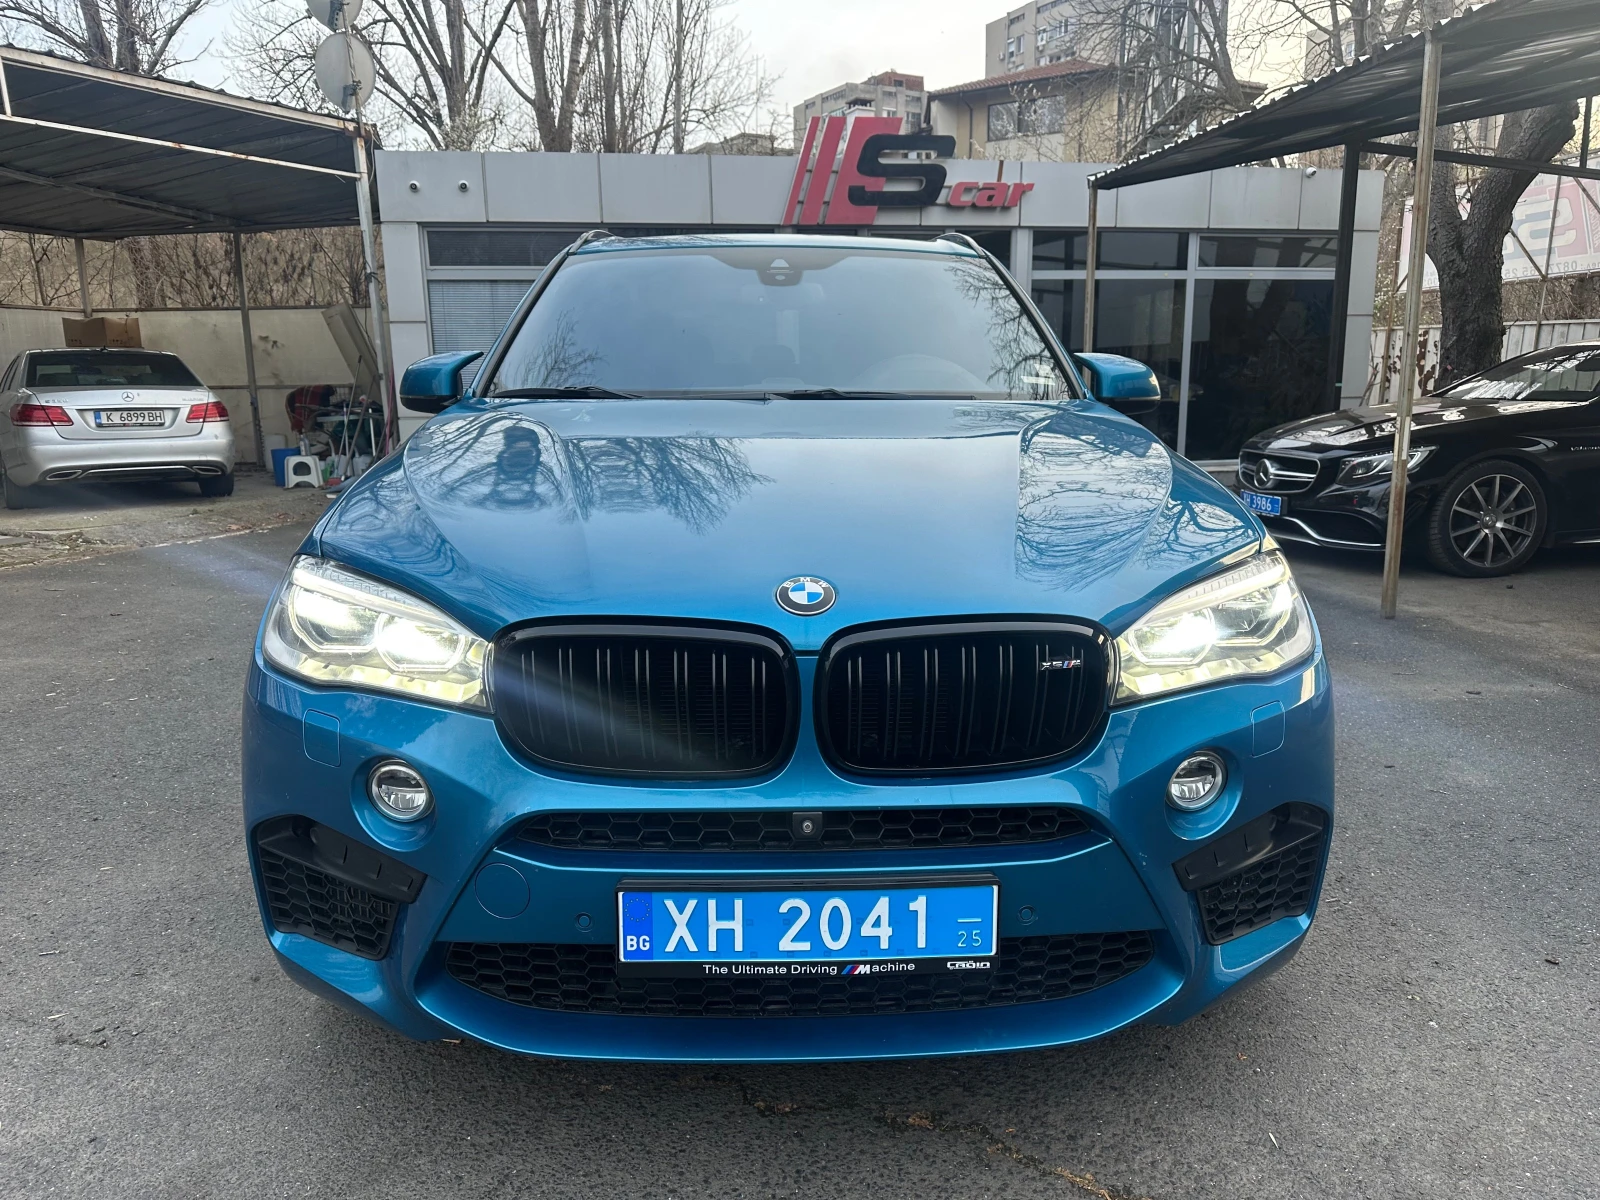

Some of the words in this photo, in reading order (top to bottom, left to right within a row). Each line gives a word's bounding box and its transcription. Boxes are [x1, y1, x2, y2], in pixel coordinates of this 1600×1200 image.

[950, 181, 1035, 207] car
[106, 412, 114, 422] K
[120, 412, 146, 422] 6899
[147, 411, 163, 421] BH
[1252, 495, 1272, 511] 3986
[782, 577, 830, 588] BMW
[664, 898, 744, 953] XH
[778, 895, 928, 952] 2041
[626, 935, 651, 952] BG
[957, 930, 983, 948] 25
[703, 964, 728, 974] The
[732, 964, 787, 974] Ultimate
[791, 964, 837, 975] Driving
[854, 962, 916, 974] Machine
